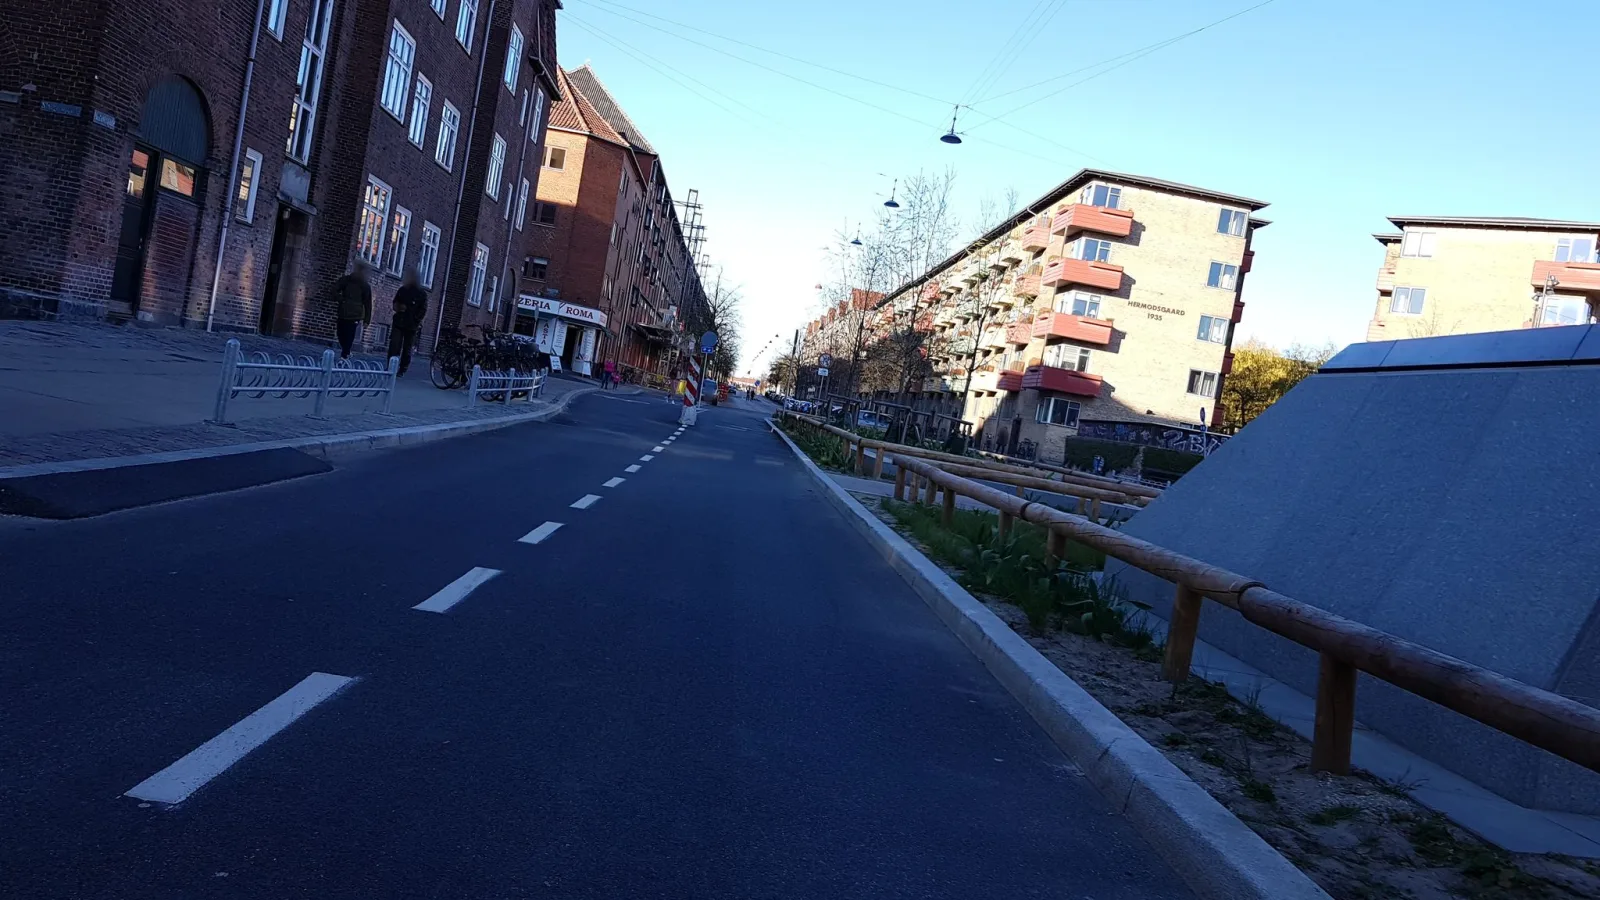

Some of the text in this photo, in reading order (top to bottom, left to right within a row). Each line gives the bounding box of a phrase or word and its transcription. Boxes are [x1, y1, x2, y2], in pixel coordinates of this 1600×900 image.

[566, 306, 593, 319] ROMA
[1127, 300, 1186, 316] HERMODSGAARD
[1147, 313, 1163, 321] 1935
[541, 321, 549, 345] ASTA
